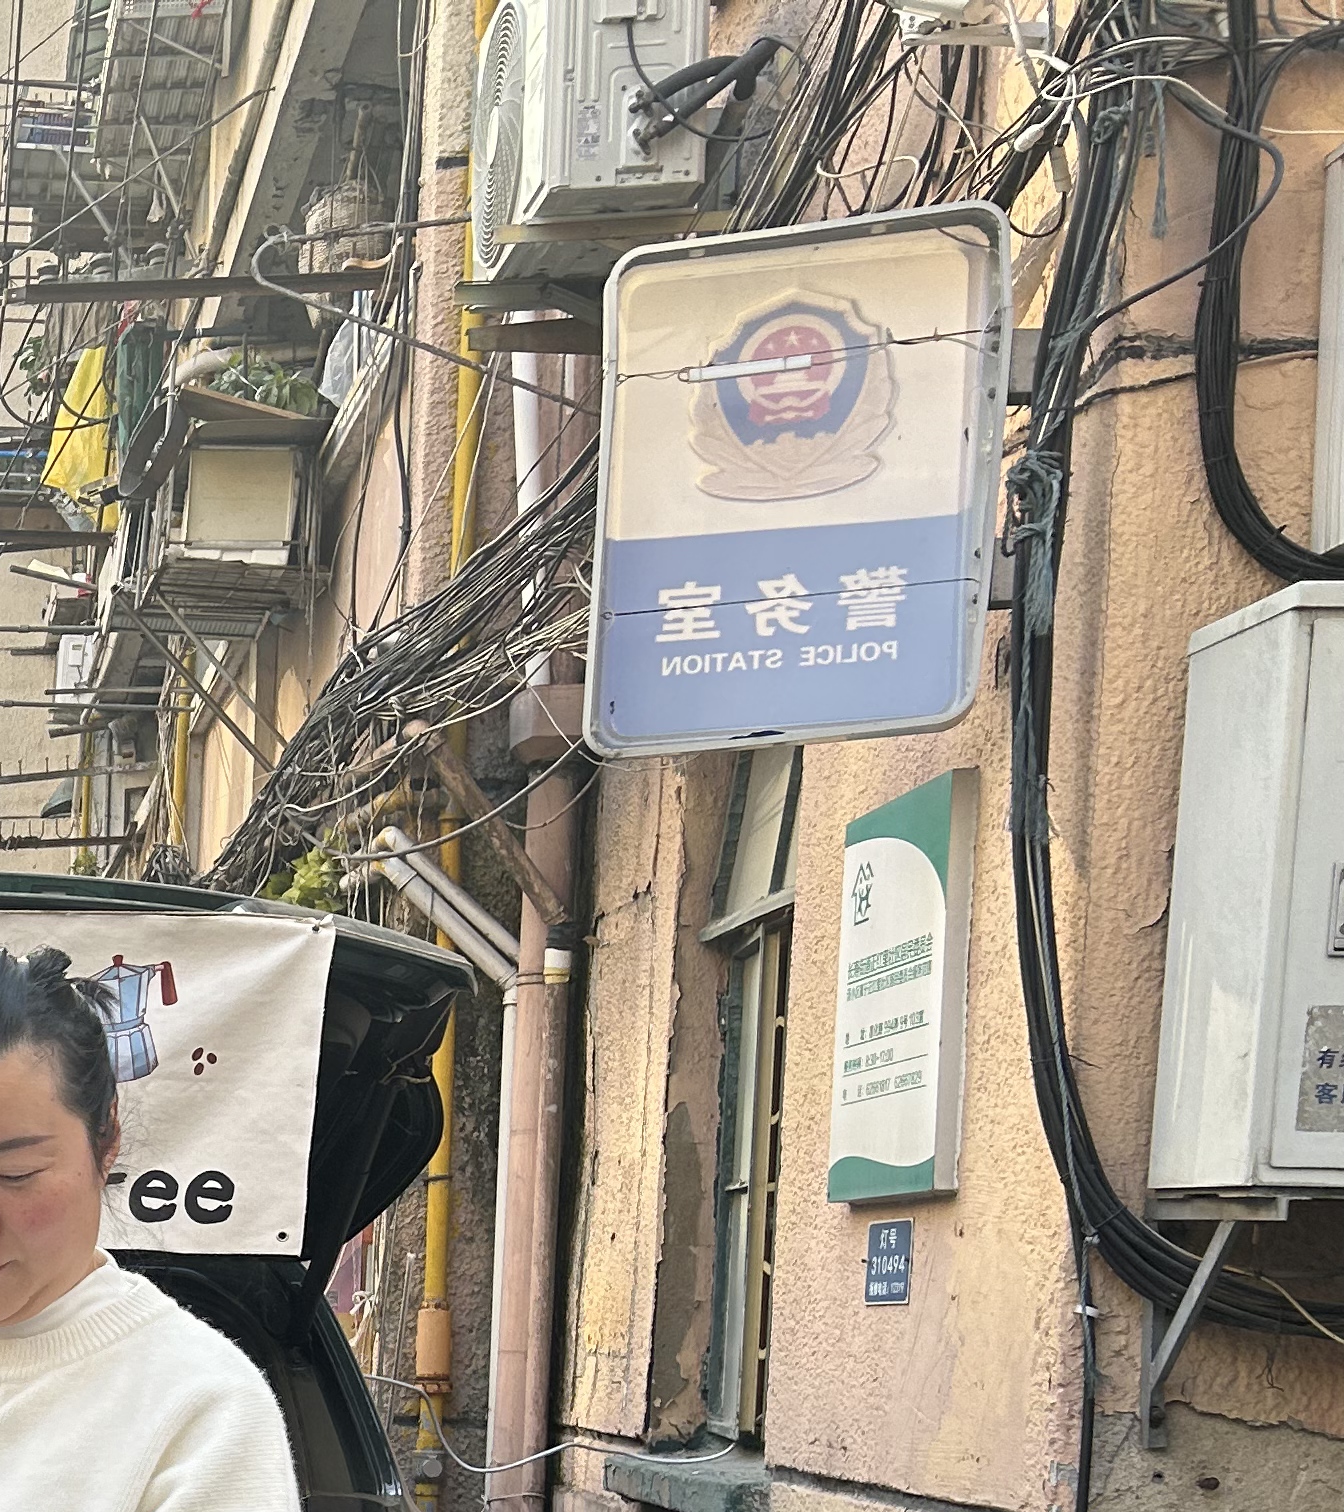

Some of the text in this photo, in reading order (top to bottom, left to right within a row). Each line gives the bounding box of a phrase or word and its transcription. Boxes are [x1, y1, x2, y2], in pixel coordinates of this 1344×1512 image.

[1316, 1048, 1344, 1069] 有
[1315, 1083, 1344, 1104] 客
[879, 1228, 897, 1249] 灯号
[871, 1254, 905, 1275] 310494
